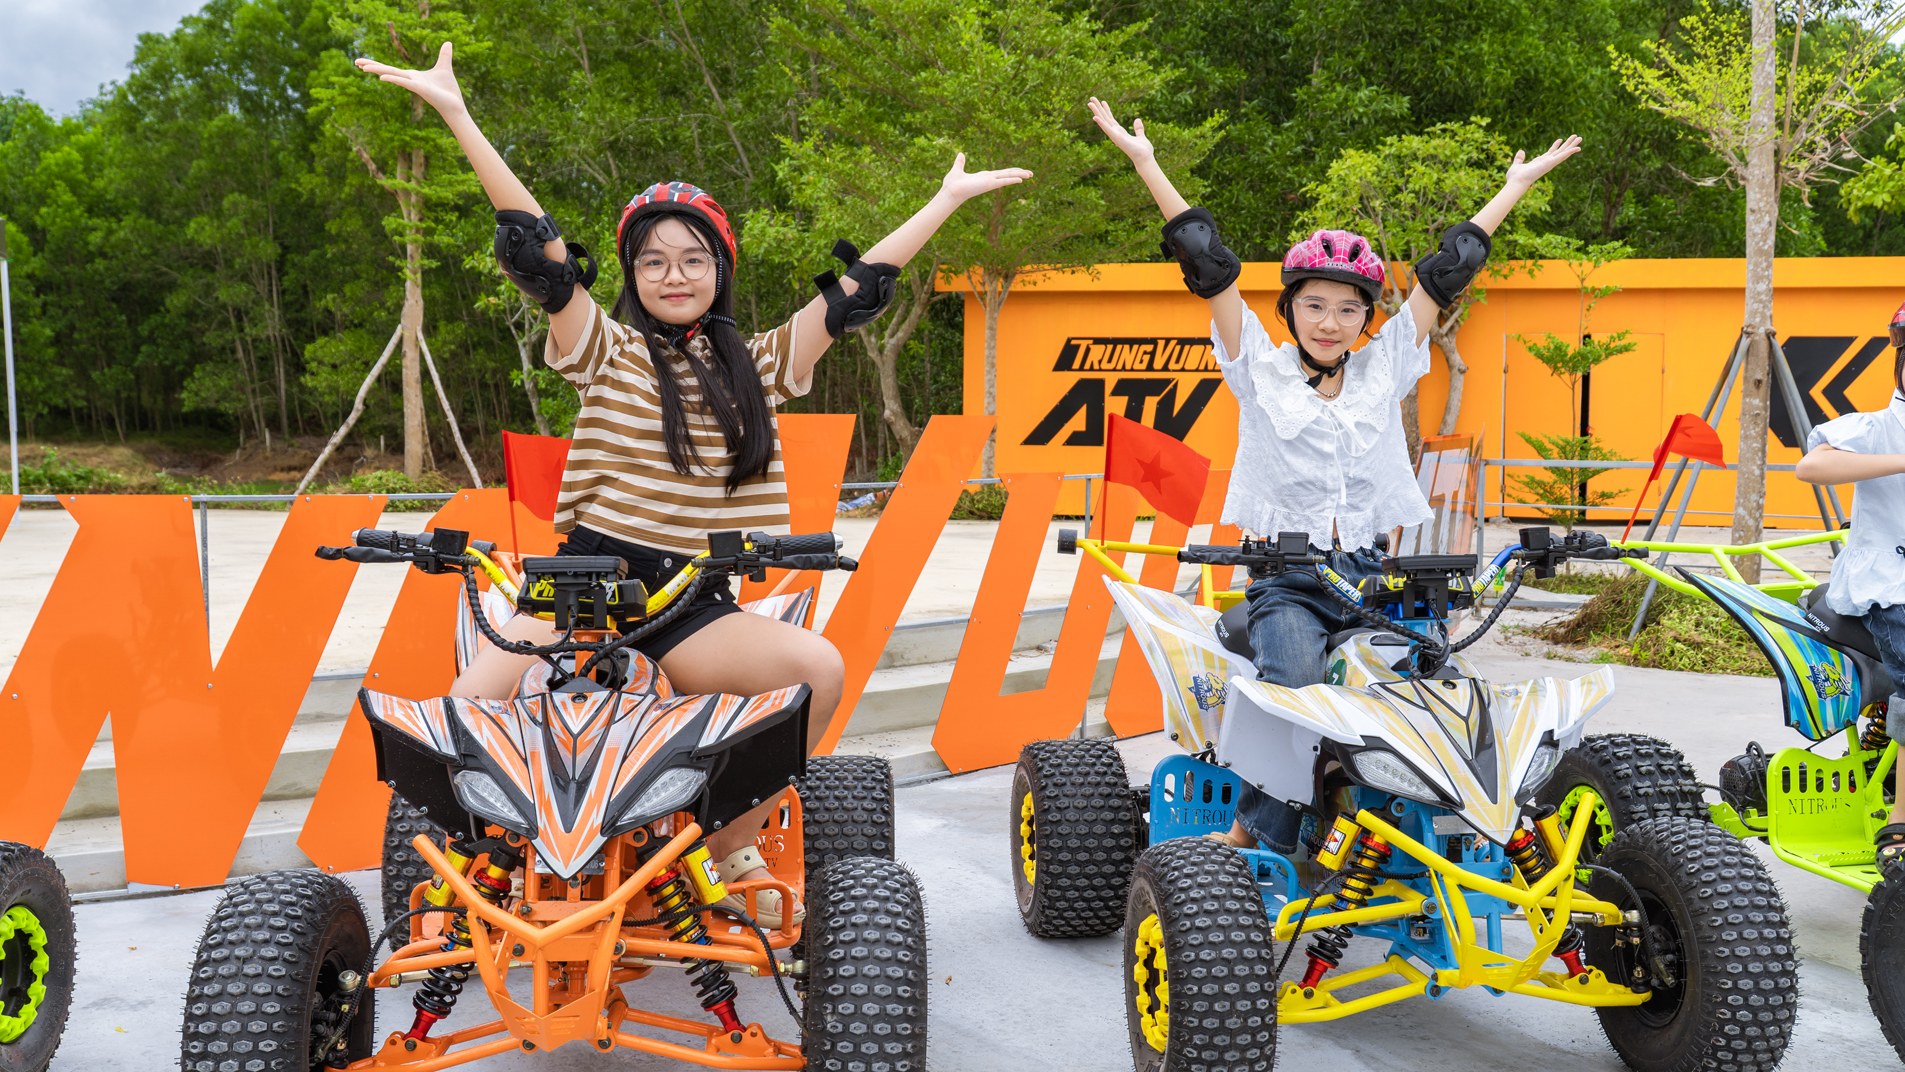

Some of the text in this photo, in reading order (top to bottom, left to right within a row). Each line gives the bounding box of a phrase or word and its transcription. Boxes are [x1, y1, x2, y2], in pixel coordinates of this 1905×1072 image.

[1068, 339, 1221, 370] TRUNG VUON
[1020, 378, 1224, 446] ATV
[1807, 612, 1831, 632] NITROUS
[1195, 676, 1209, 710] NITROUS
[1169, 807, 1237, 827] NITROU
